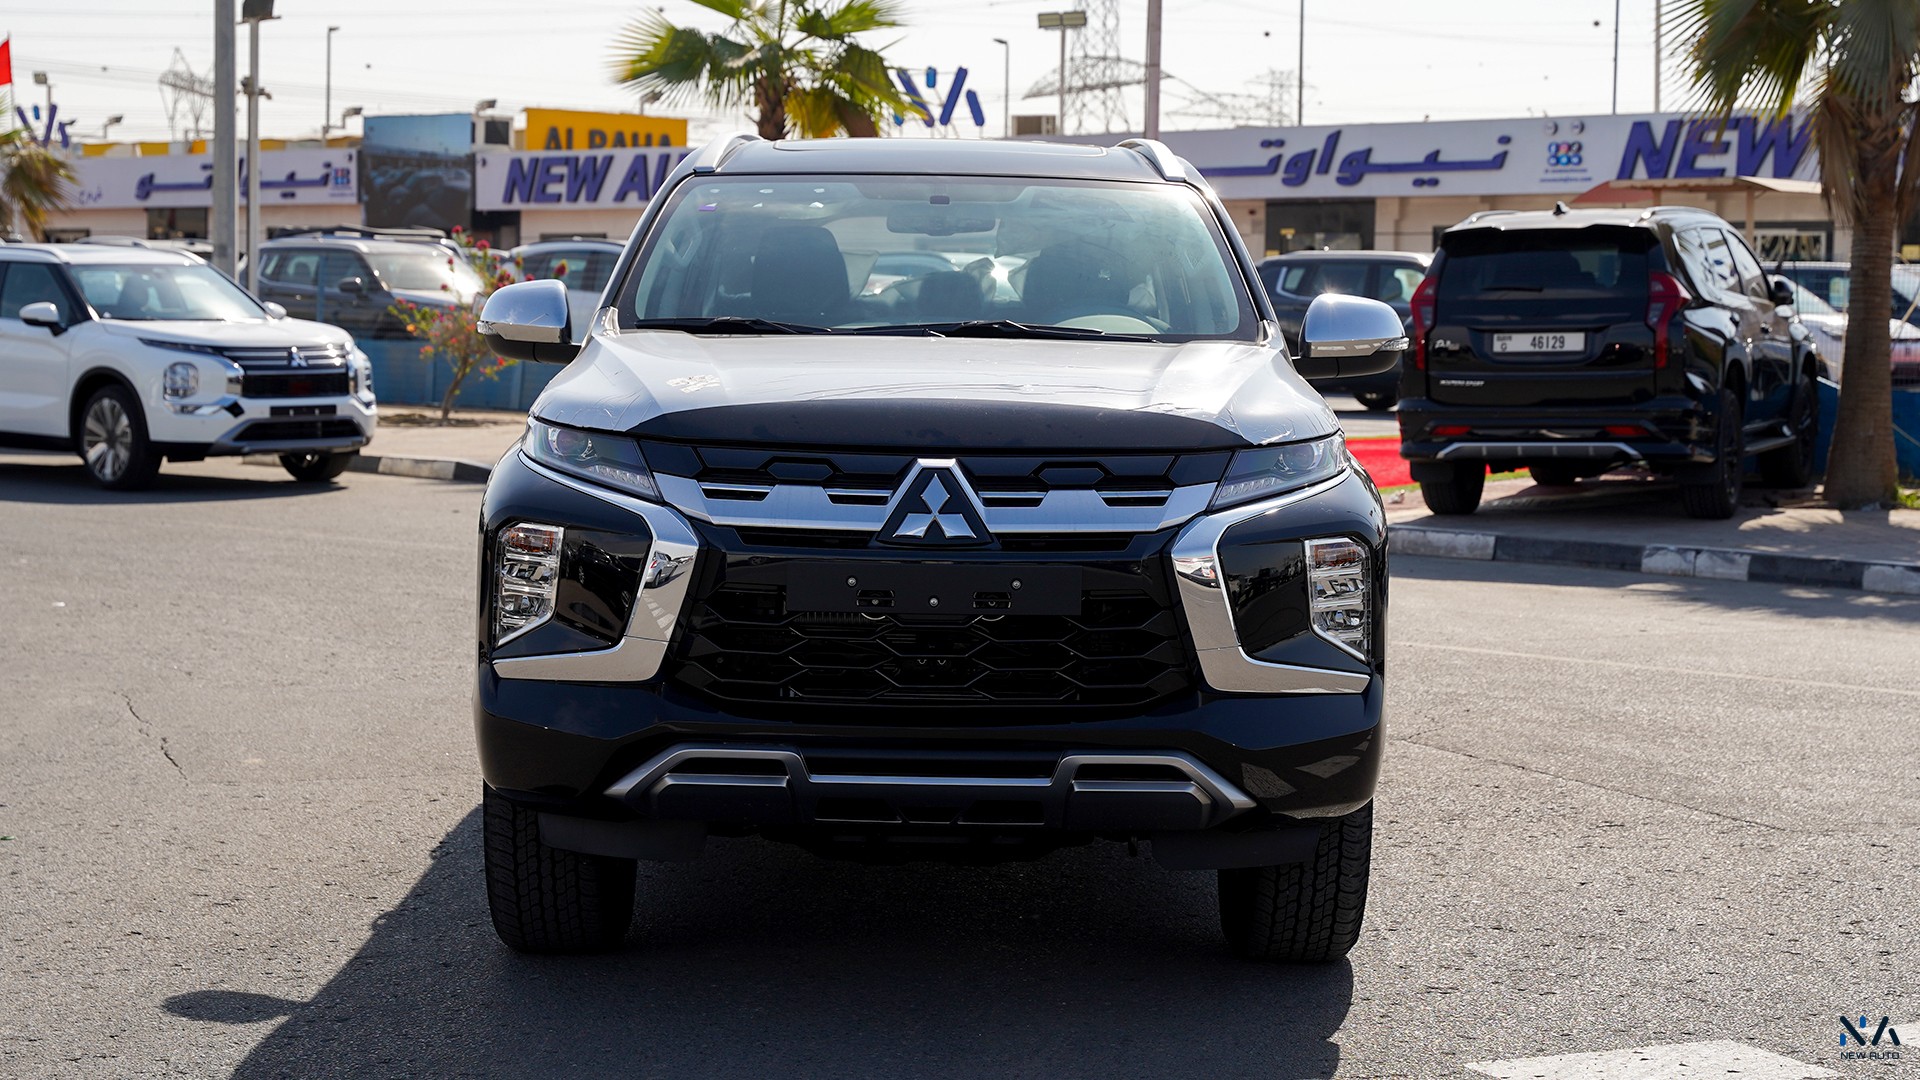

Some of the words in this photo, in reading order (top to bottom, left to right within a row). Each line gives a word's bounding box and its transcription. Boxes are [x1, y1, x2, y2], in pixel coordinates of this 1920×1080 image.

[1616, 114, 1814, 180] NEW
[502, 156, 614, 204] NEW
[614, 153, 692, 203] AU
[1530, 335, 1566, 349] 46129
